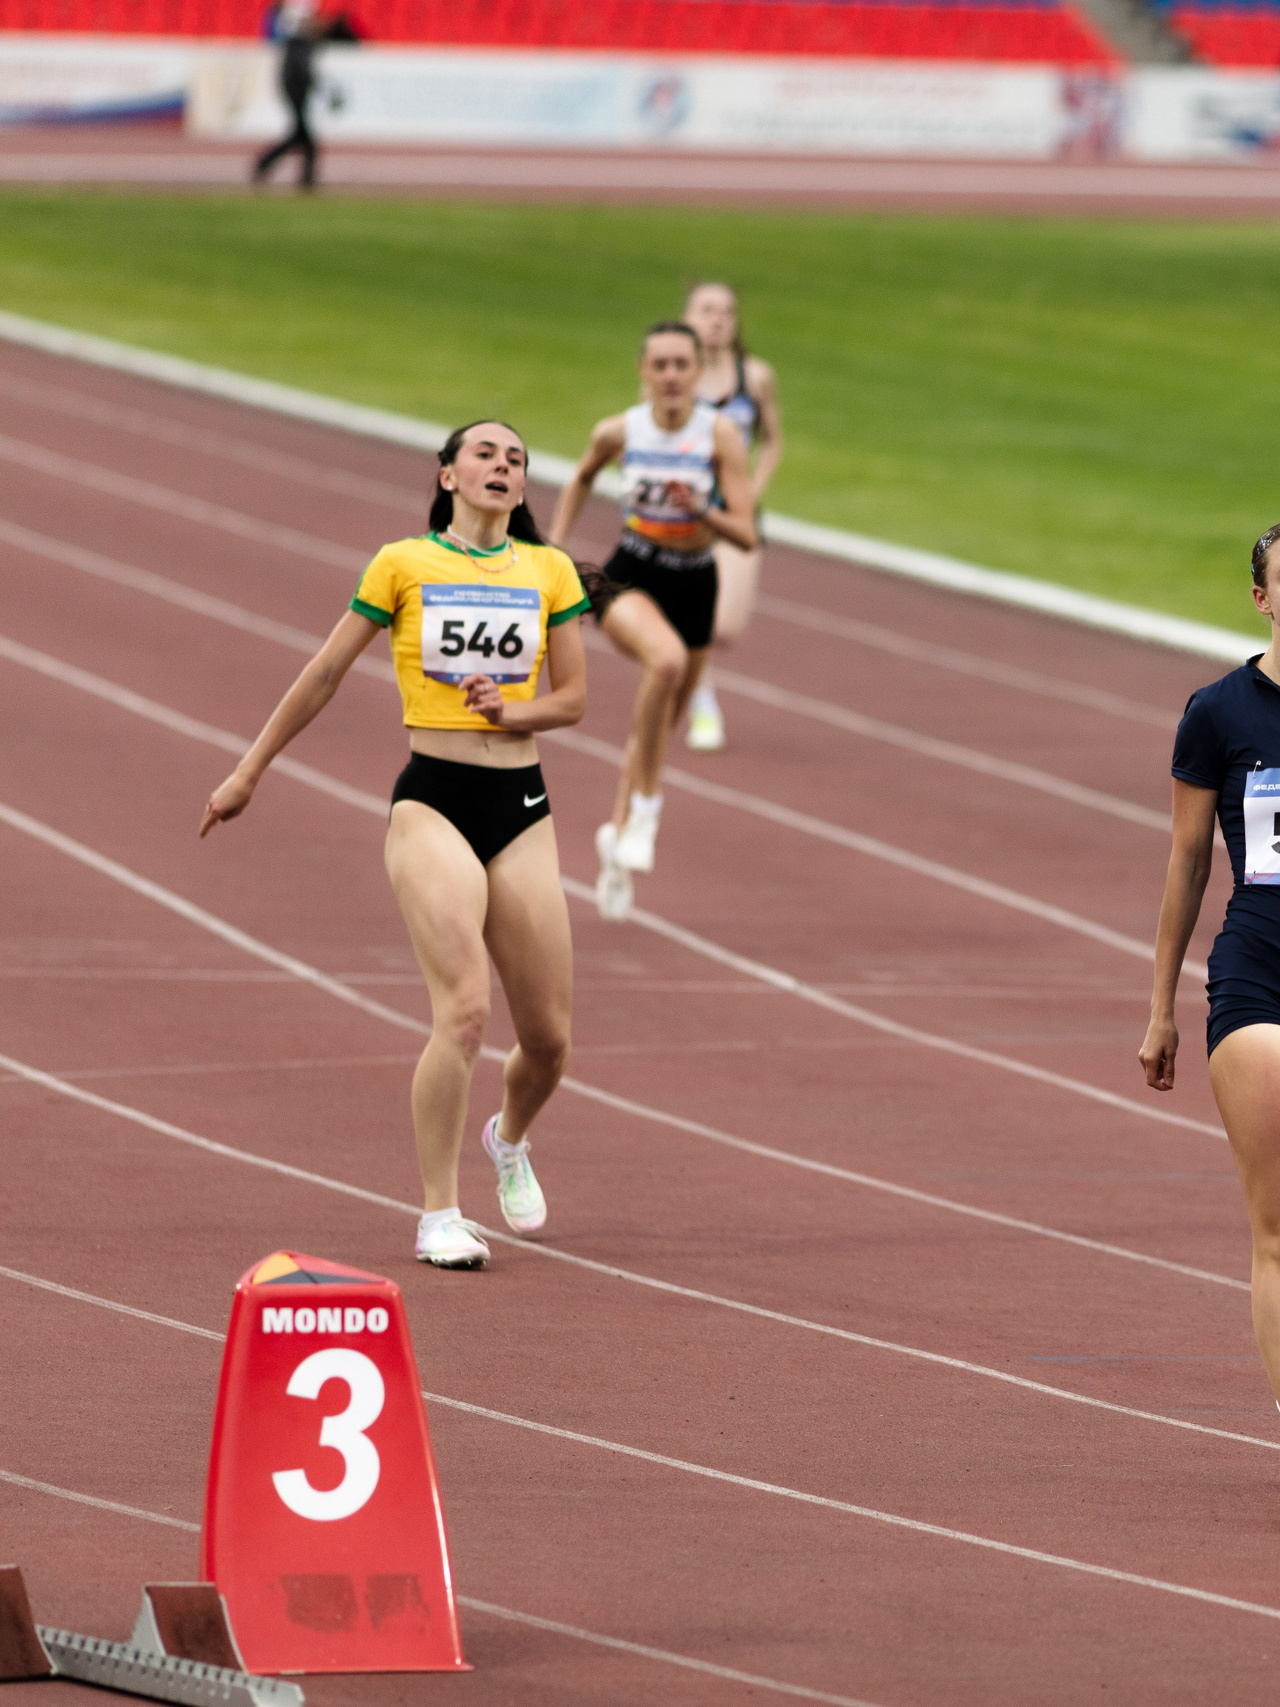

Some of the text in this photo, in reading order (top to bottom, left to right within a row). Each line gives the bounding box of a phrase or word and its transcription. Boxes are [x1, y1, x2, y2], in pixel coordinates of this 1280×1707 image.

[440, 620, 524, 659] 546
[262, 1306, 390, 1334] MONDO
[271, 1347, 386, 1522] 3
